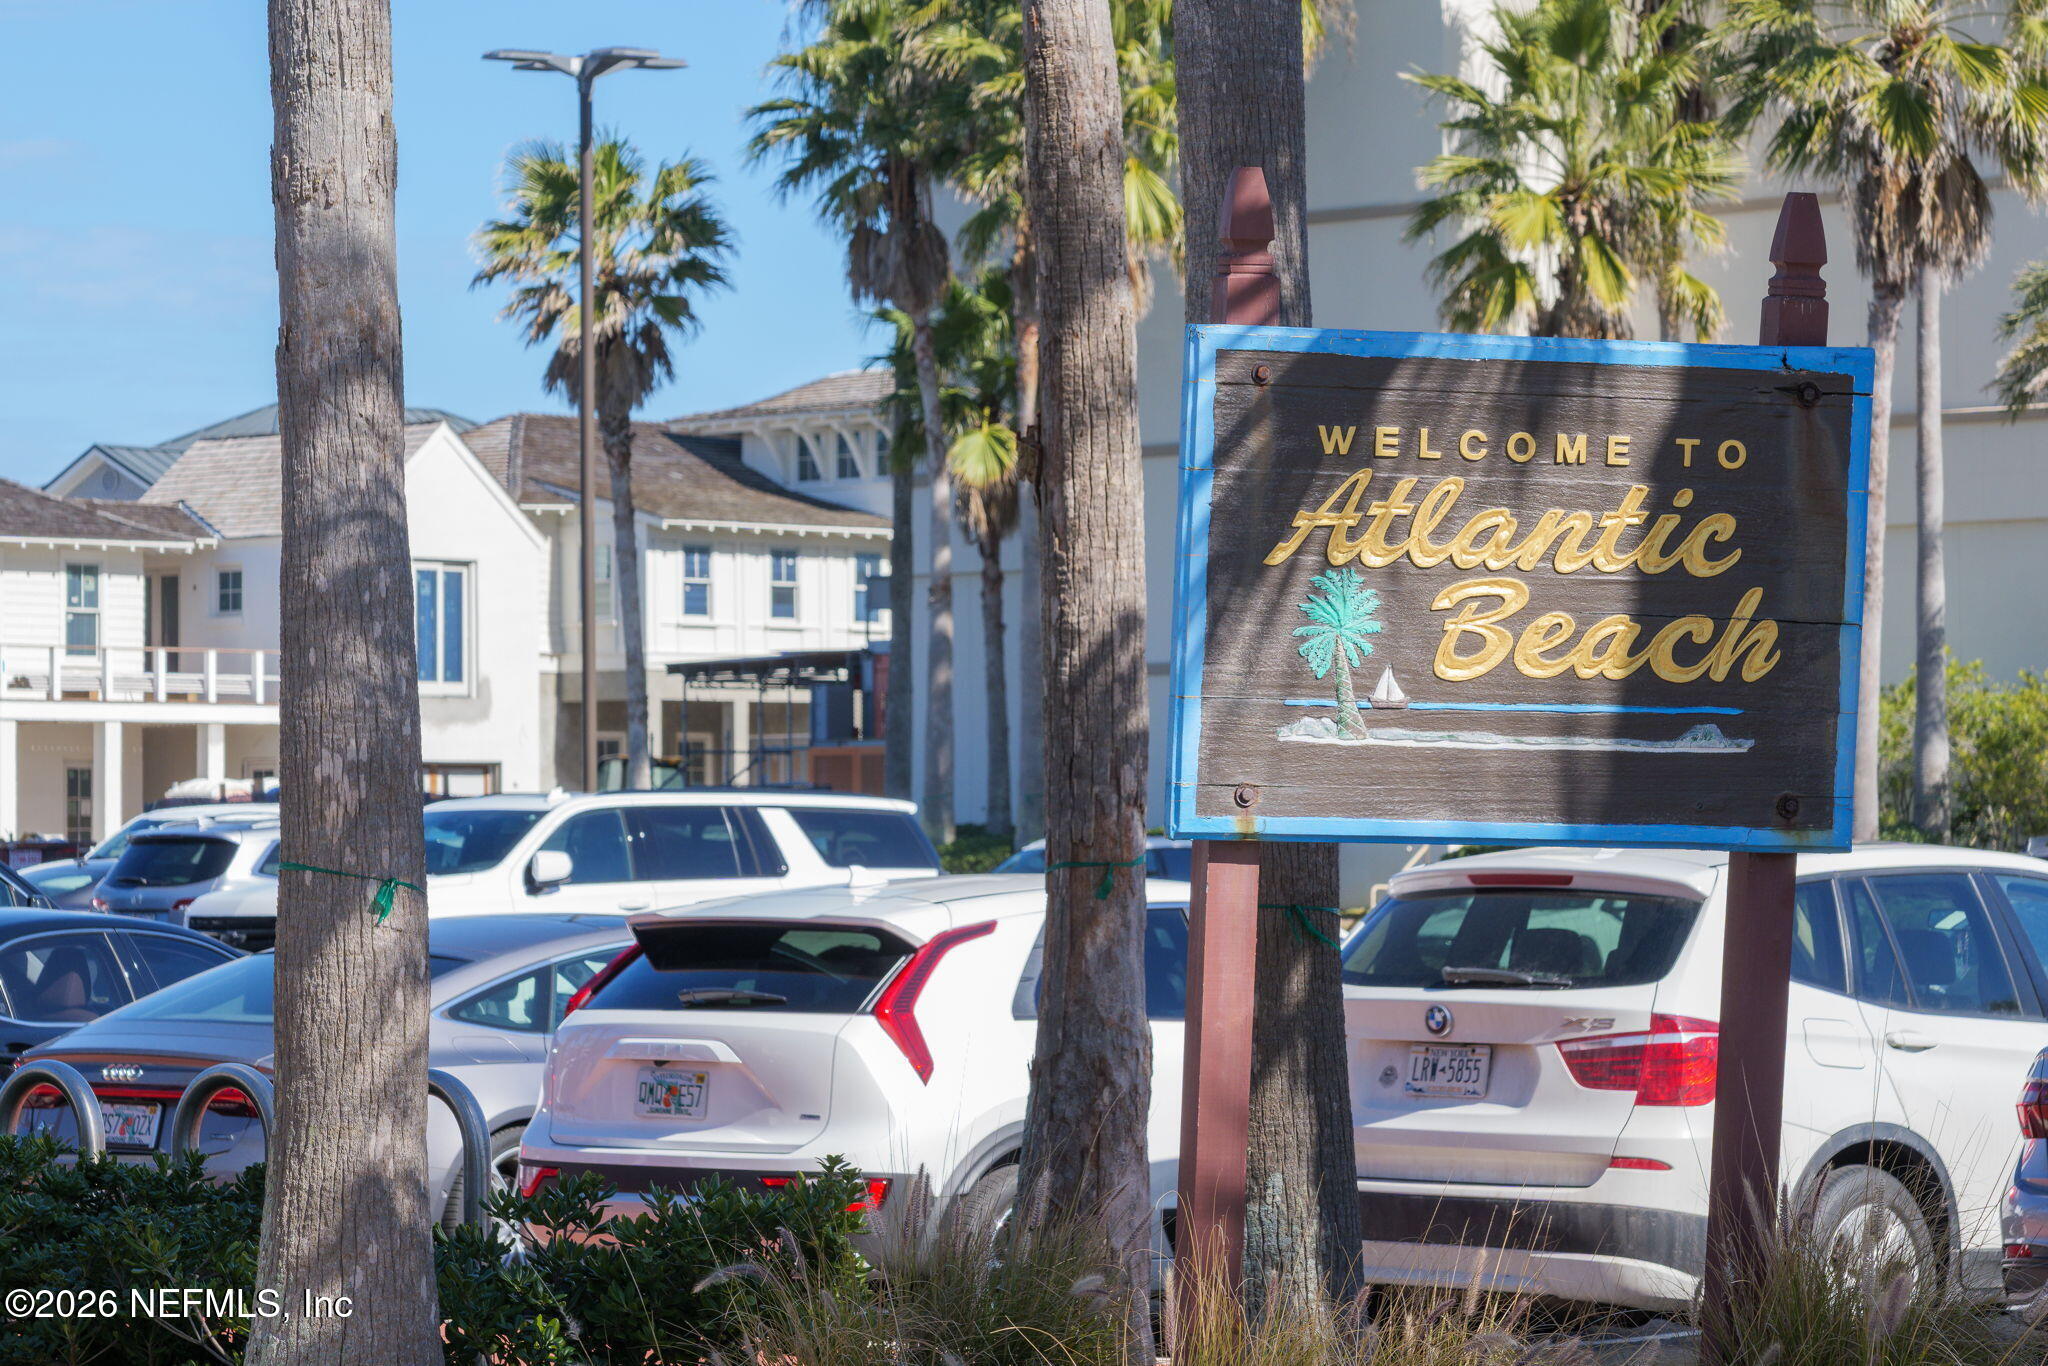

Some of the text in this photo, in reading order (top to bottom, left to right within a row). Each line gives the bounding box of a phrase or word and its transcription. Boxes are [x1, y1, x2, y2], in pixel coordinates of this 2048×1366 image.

[1318, 424, 1747, 469] WELCOME TO
[1263, 468, 1742, 577] Atlantic
[1430, 577, 1781, 683] Beach
